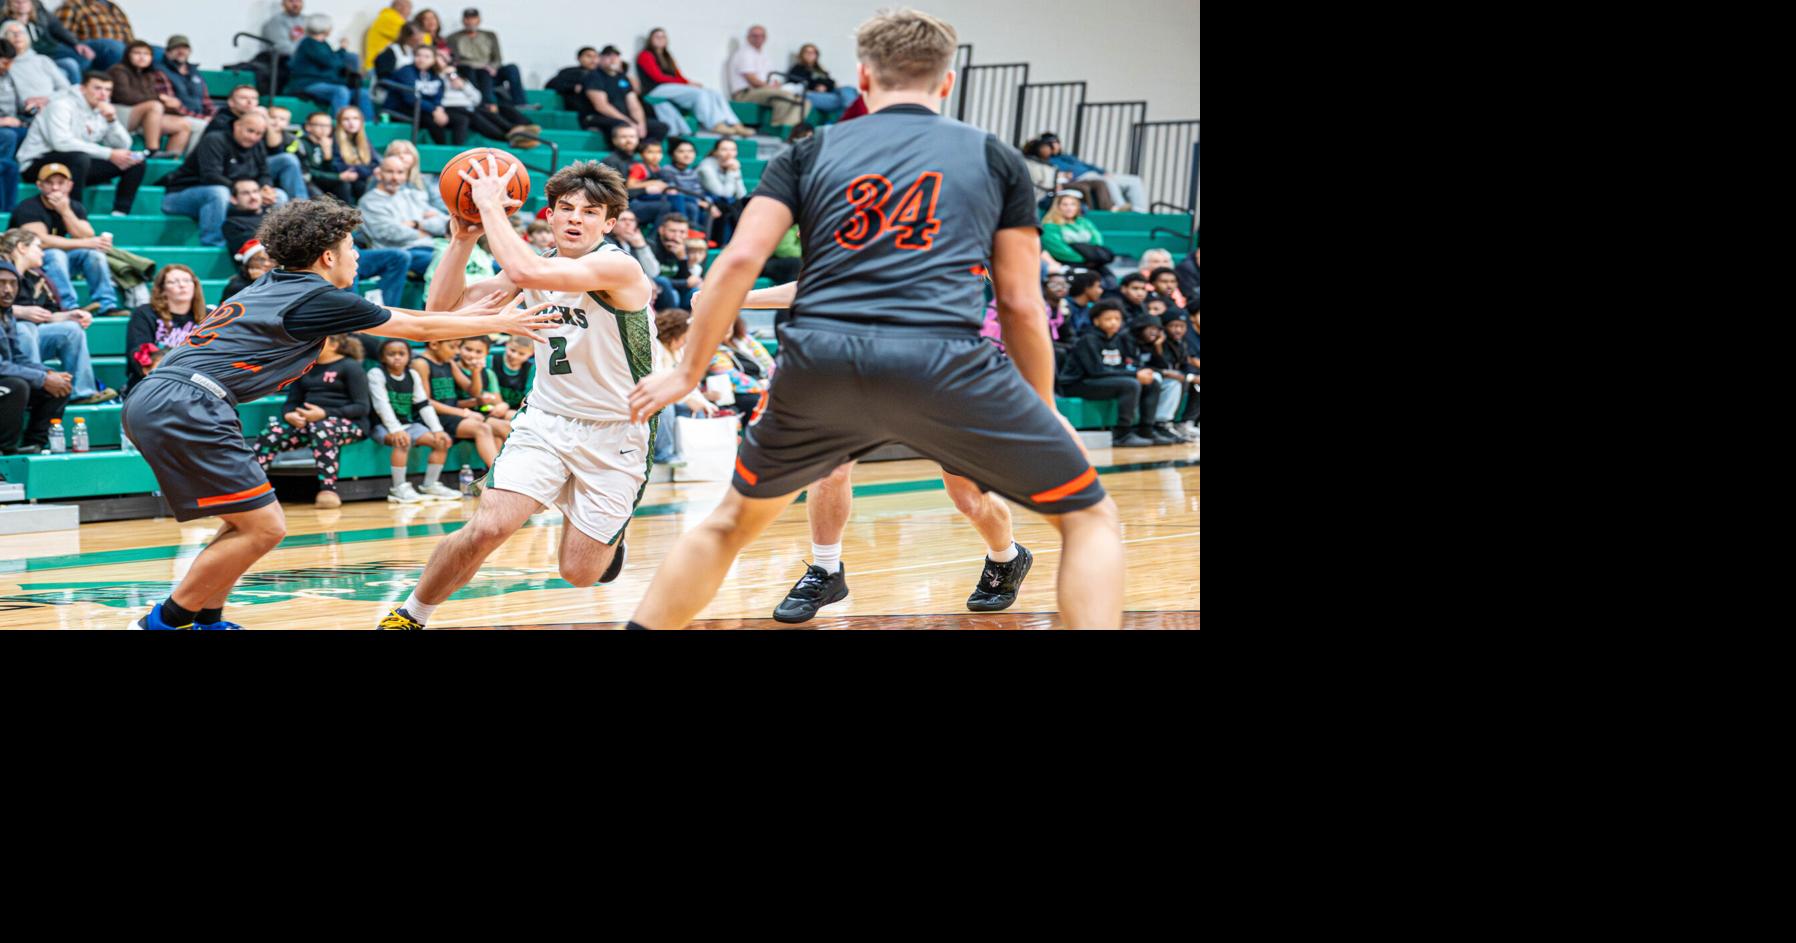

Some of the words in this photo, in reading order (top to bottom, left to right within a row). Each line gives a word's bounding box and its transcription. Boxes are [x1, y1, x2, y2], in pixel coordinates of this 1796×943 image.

[833, 170, 944, 251] 34
[181, 301, 246, 348] 2
[548, 336, 573, 375] 2
